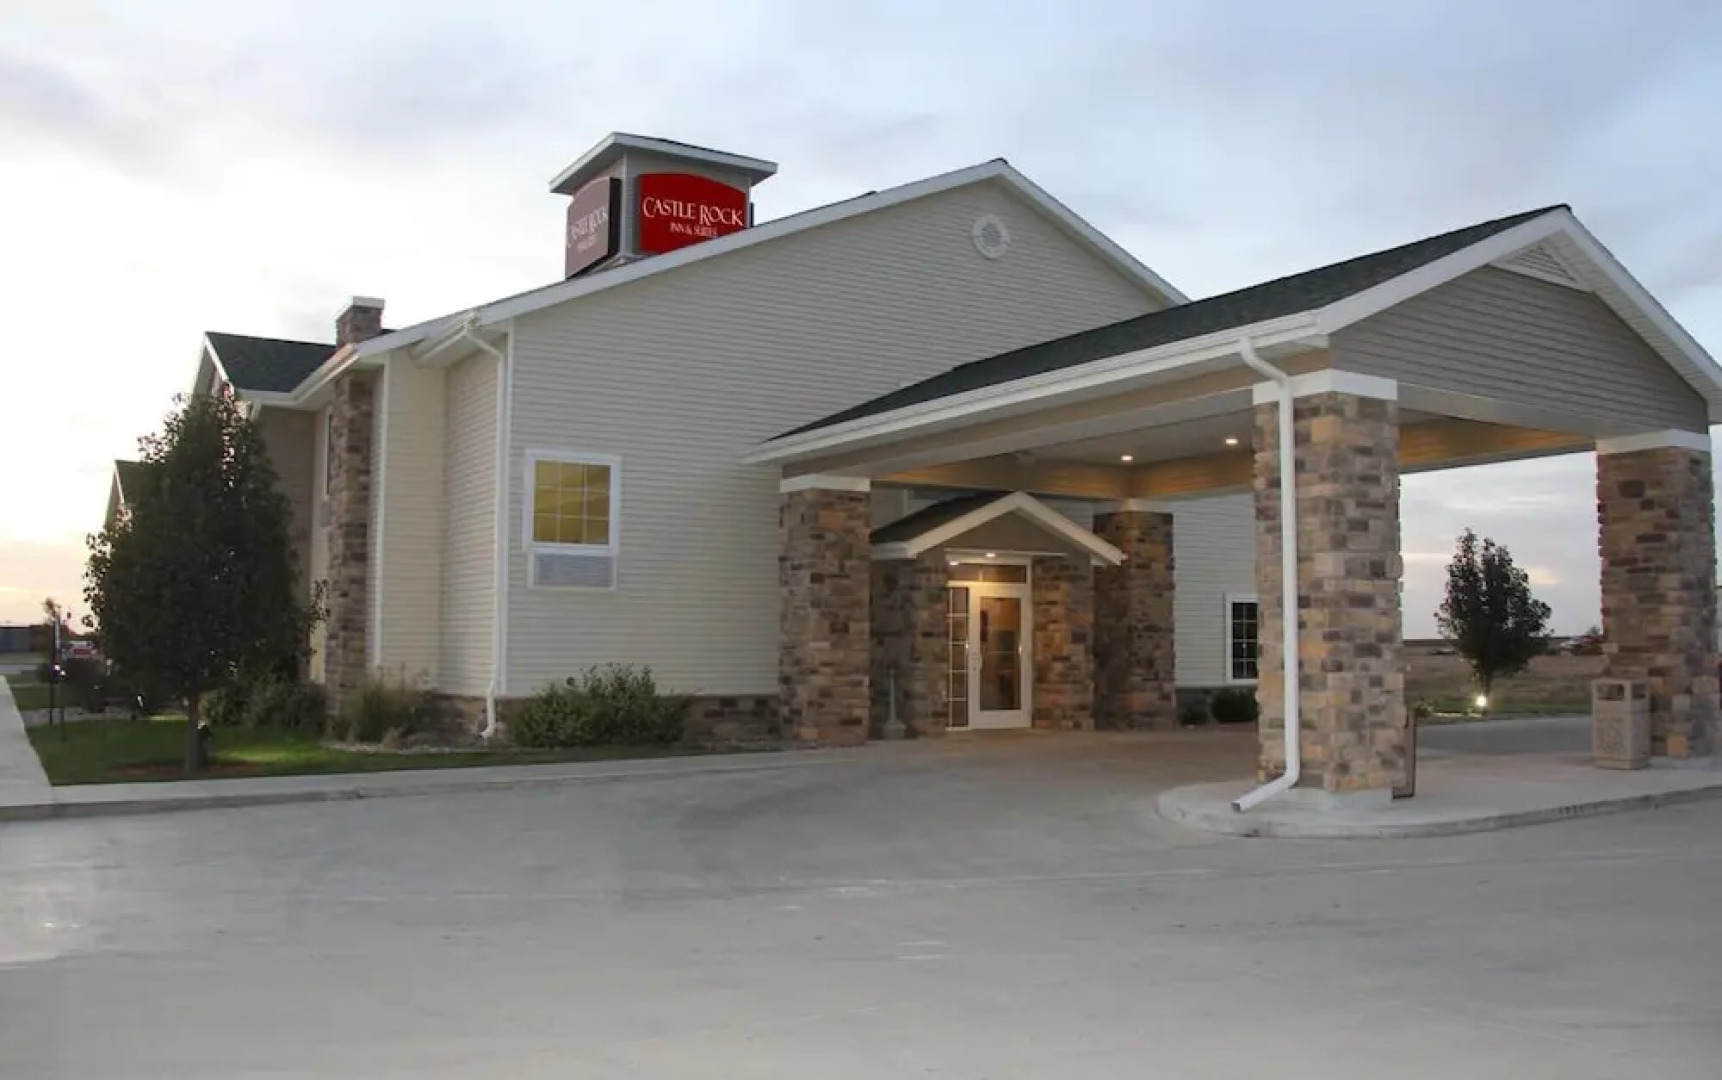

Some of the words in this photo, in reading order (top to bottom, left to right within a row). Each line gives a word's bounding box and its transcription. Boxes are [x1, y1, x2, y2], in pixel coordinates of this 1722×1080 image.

[643, 196, 697, 220] CASTLE
[699, 204, 744, 227] ROCK
[670, 221, 685, 234] INN
